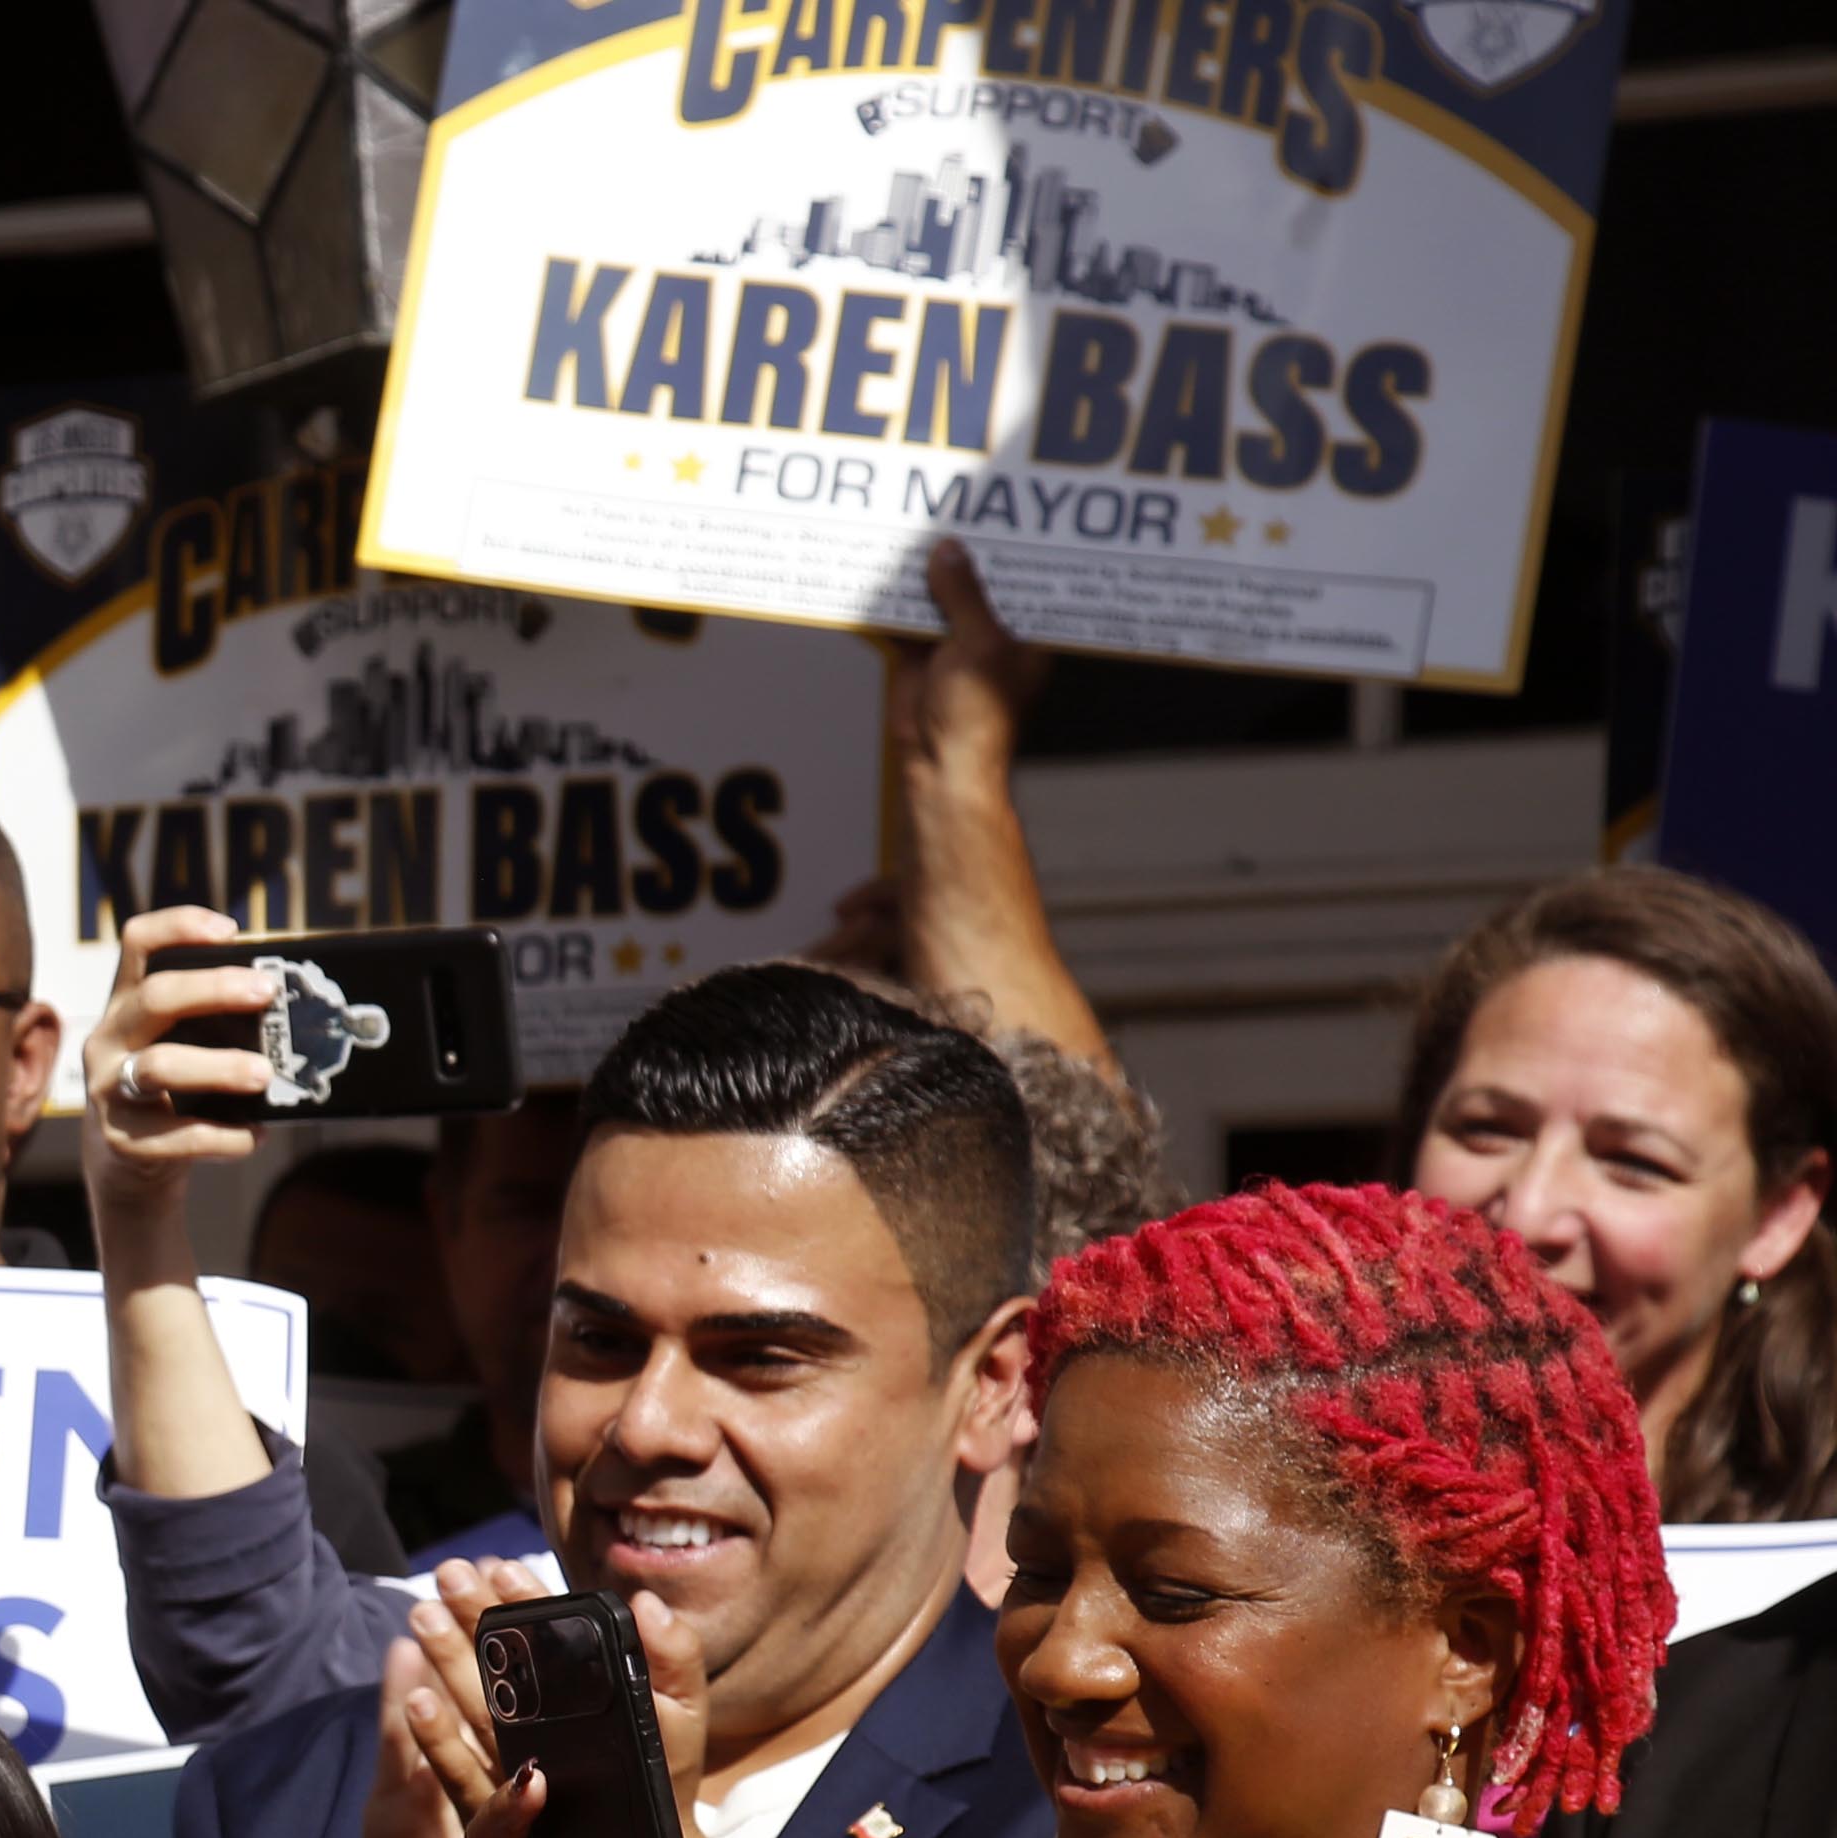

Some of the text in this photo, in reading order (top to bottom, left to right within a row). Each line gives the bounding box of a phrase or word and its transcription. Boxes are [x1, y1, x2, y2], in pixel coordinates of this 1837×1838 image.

[891, 80, 1140, 140] SUPPORT
[525, 256, 1434, 500] KAREN BASS
[734, 447, 1178, 546] FOR MAYOR
[76, 766, 786, 943] KAREN BASS
